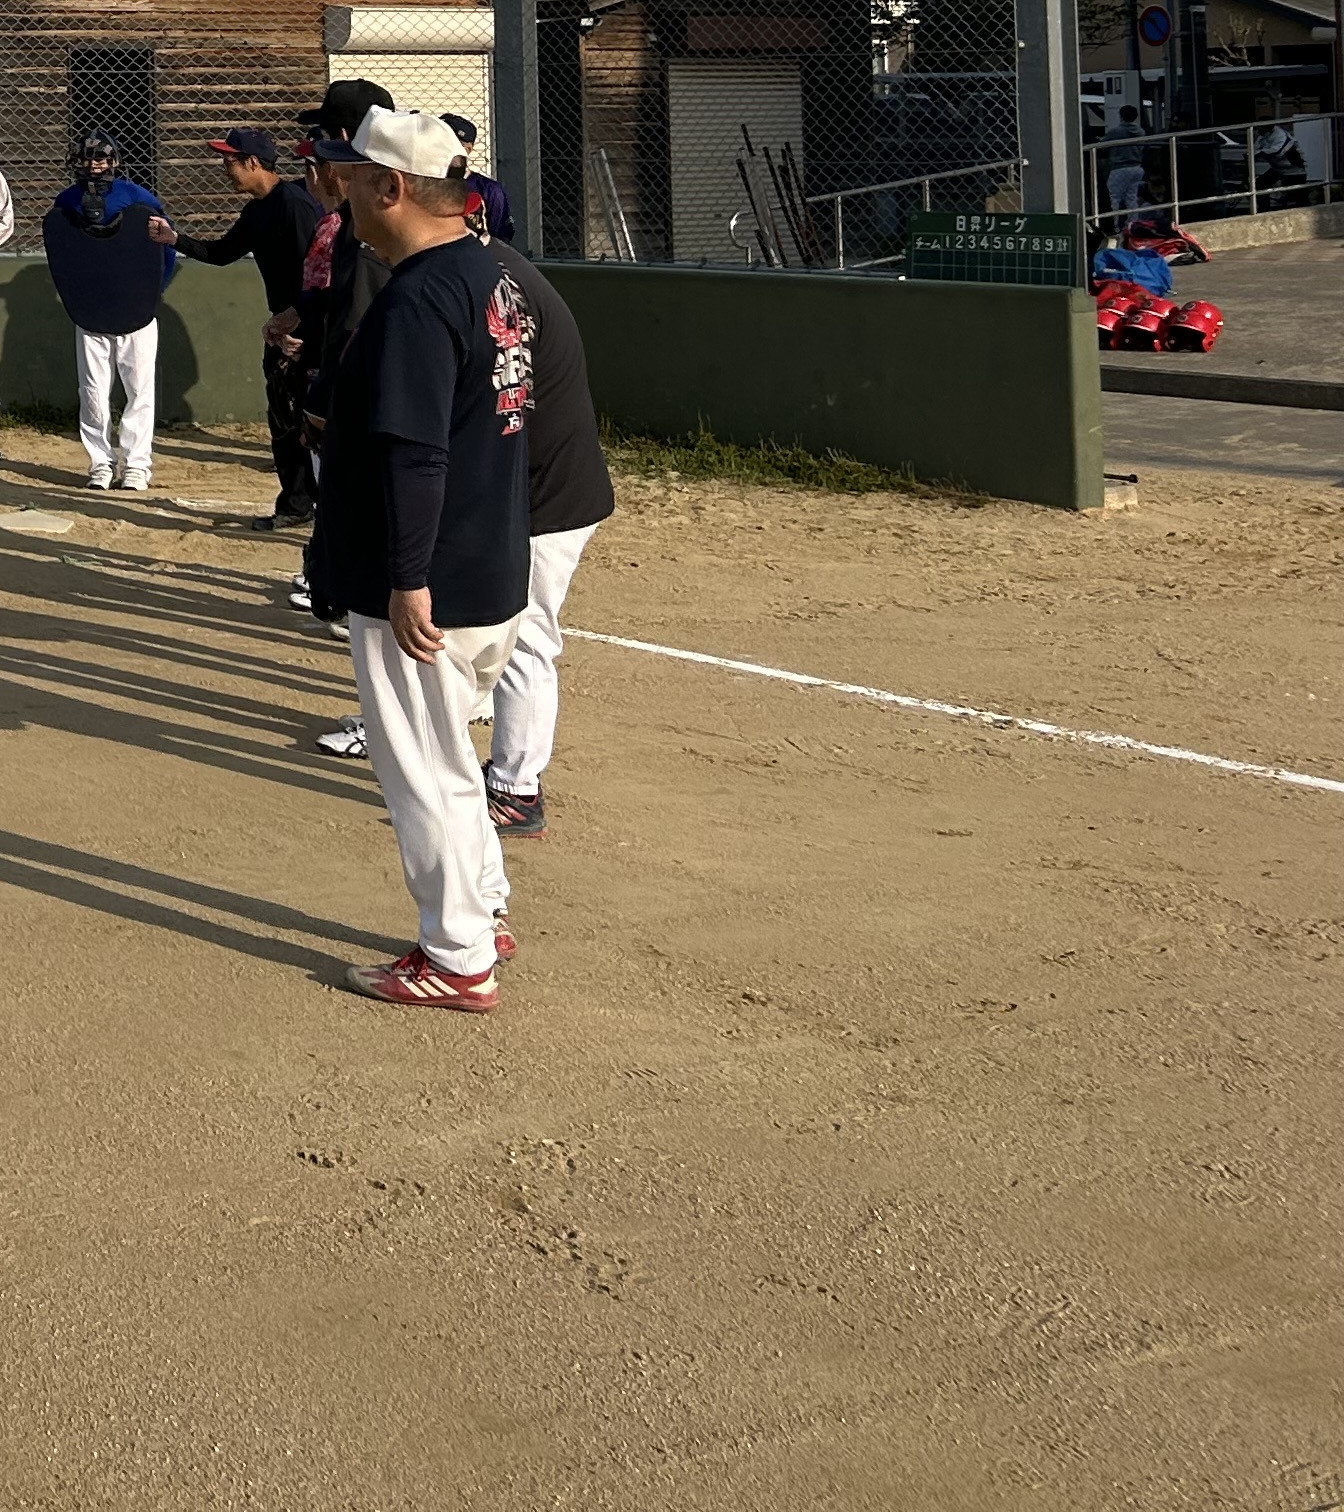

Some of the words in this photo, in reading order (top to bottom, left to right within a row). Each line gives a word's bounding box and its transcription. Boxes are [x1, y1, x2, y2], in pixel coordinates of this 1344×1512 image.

[915, 236, 941, 249] チーム
[955, 235, 964, 249] 2
[967, 235, 976, 250] 3
[980, 235, 989, 250] 4
[993, 236, 1001, 251] 5
[1005, 236, 1014, 251] 6
[1018, 237, 1027, 251] 7
[1032, 237, 1040, 251] 8
[1044, 238, 1053, 252] 9
